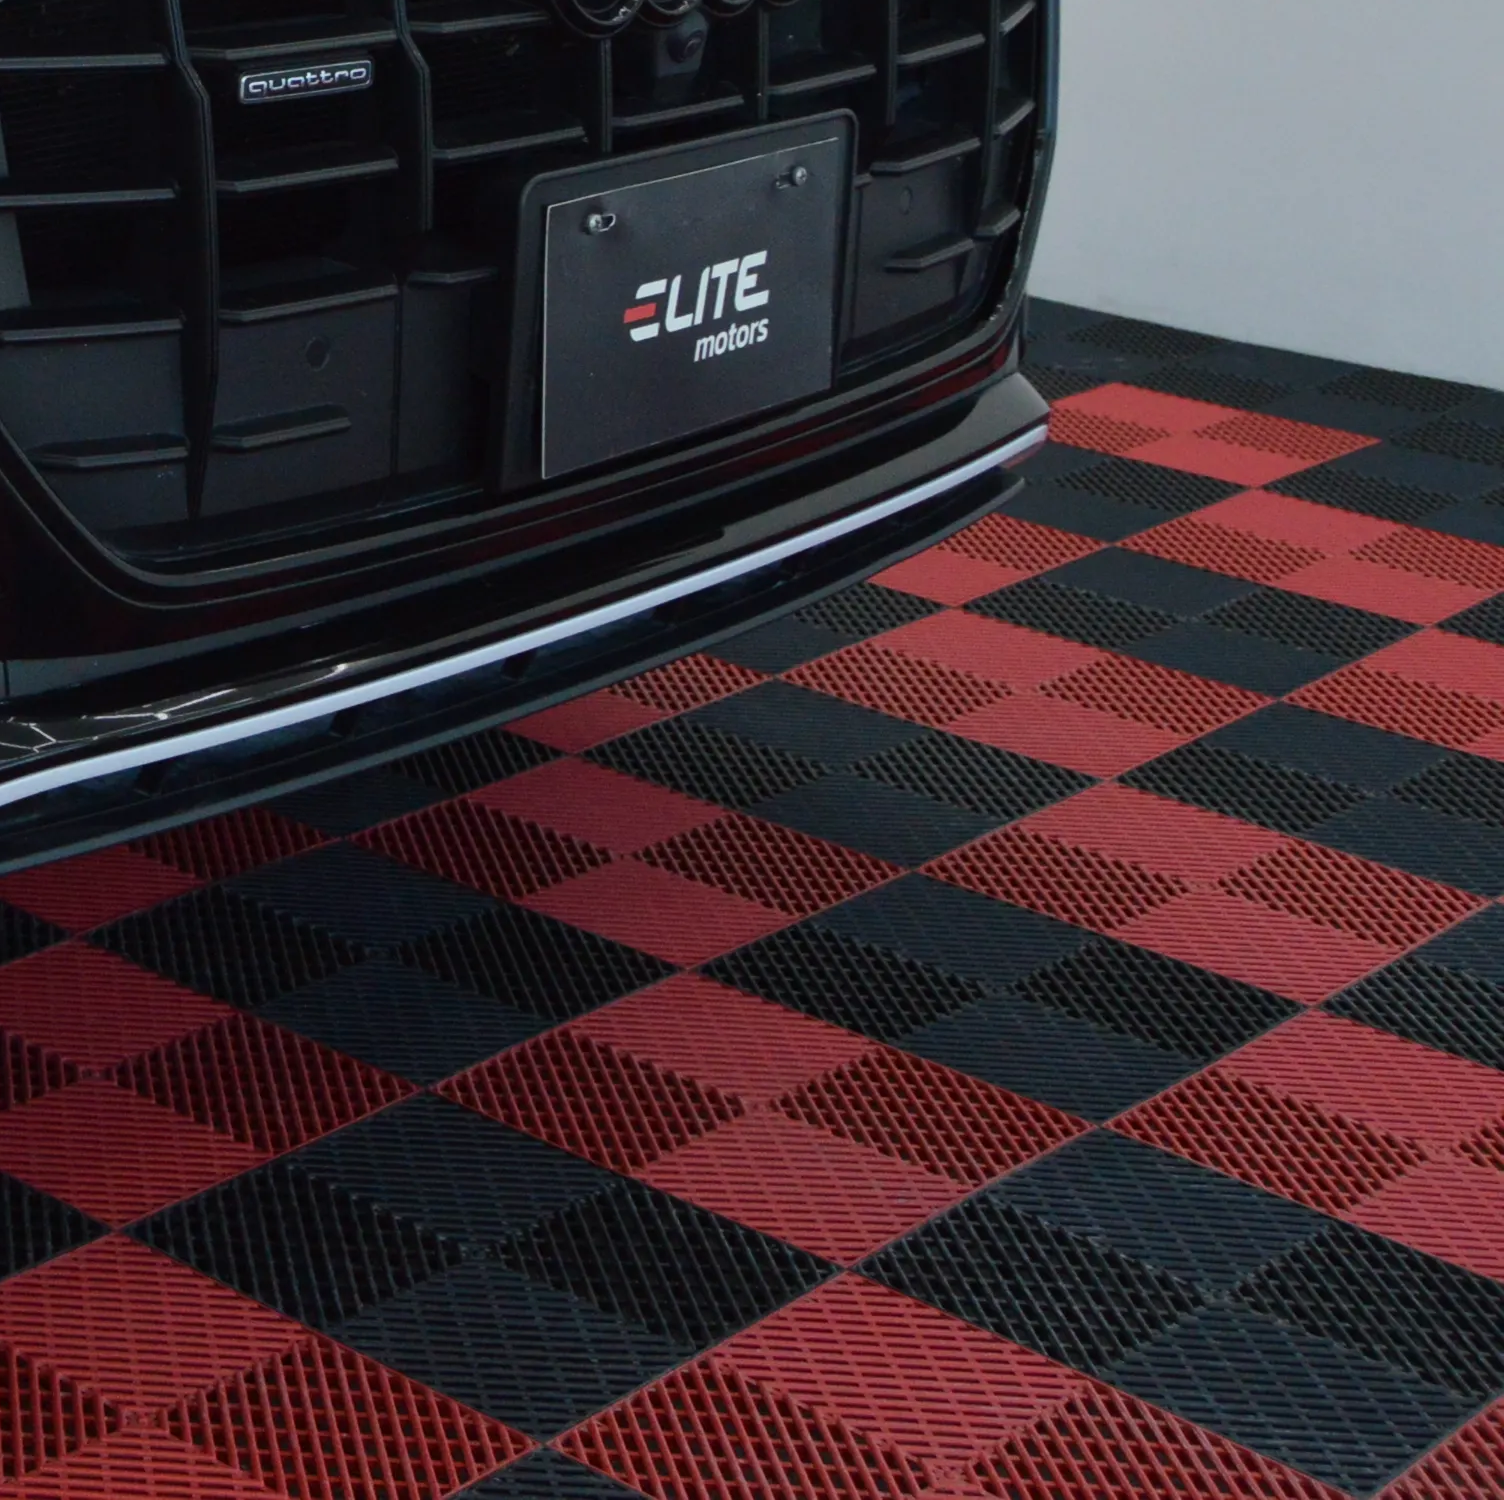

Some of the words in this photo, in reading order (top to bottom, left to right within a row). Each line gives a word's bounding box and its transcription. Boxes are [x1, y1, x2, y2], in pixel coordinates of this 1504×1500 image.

[248, 67, 367, 96] quattro
[623, 250, 770, 342] ELITE
[693, 317, 769, 362] motors
